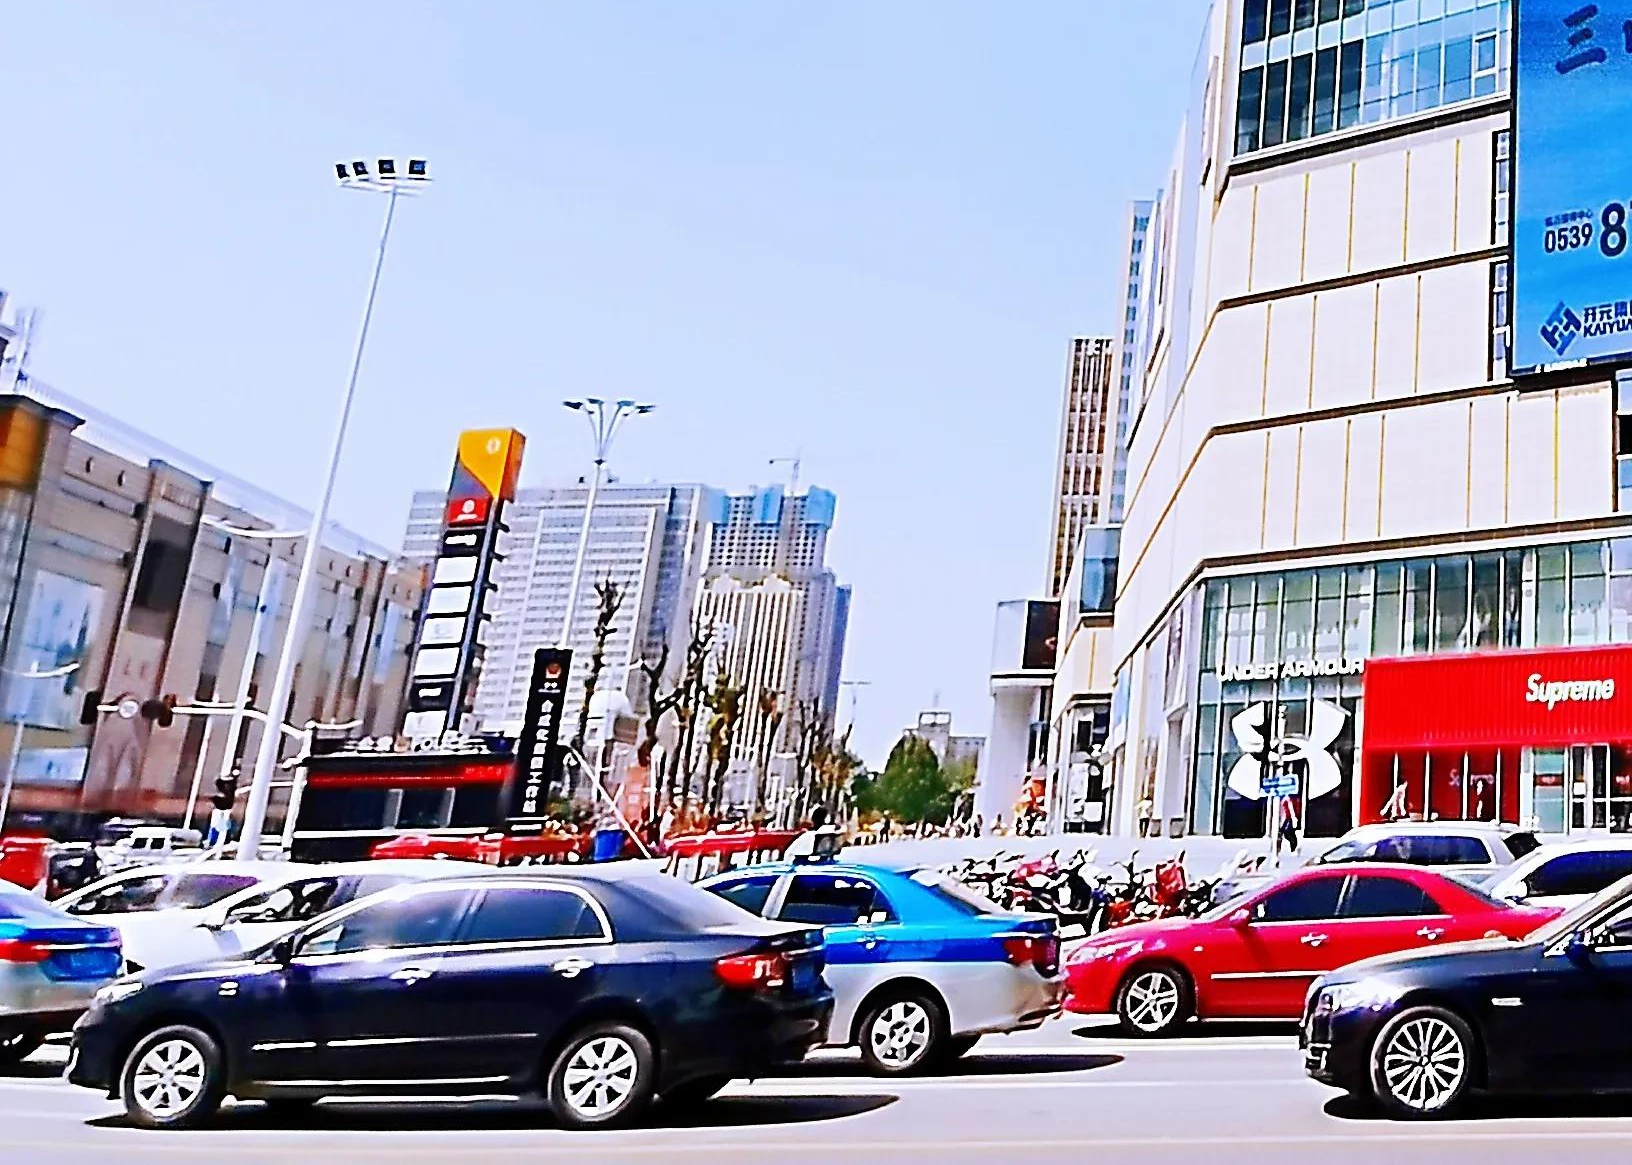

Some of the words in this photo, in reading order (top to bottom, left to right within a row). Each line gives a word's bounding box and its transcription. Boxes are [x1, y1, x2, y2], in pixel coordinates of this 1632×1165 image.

[1545, 223, 1593, 253] 0539
[1216, 663, 1278, 682] UNDER
[1281, 657, 1365, 679] ARMOUR
[1526, 673, 1615, 711] Supreme
